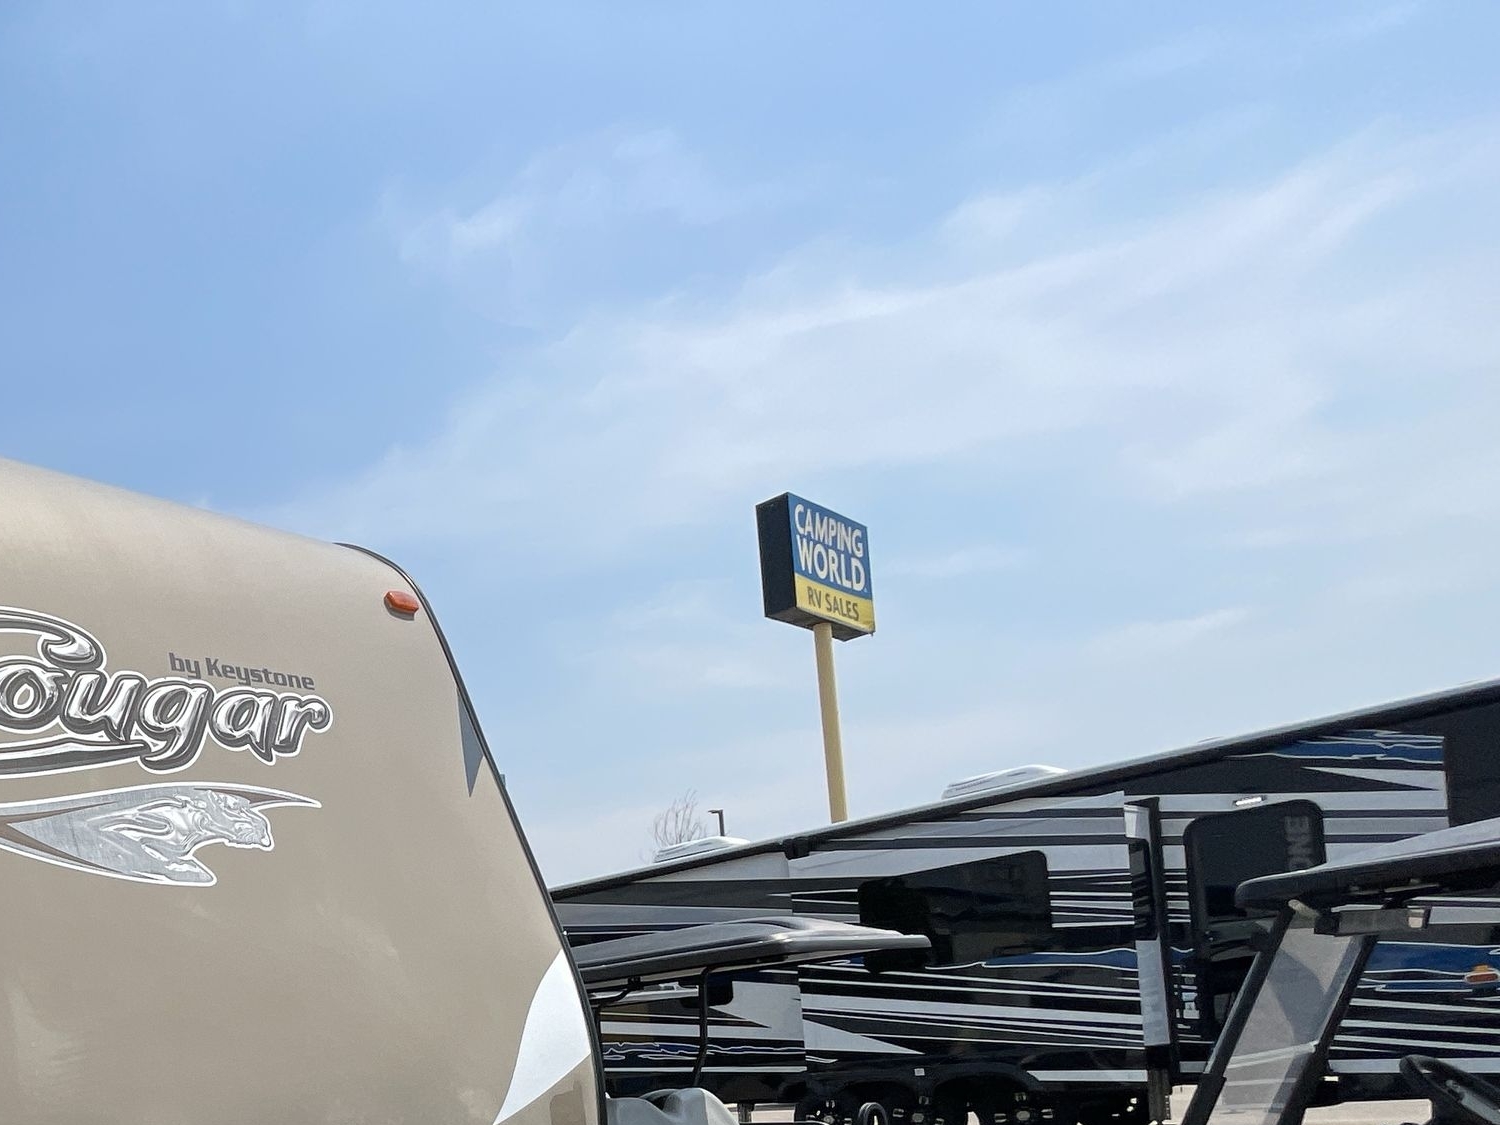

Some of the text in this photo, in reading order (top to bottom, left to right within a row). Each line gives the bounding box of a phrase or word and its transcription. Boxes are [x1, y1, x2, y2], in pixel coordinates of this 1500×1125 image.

[794, 504, 864, 558] CAMPING
[796, 534, 866, 591] WORLD
[807, 586, 860, 621] RV SALES
[168, 652, 315, 691] by Keystone
